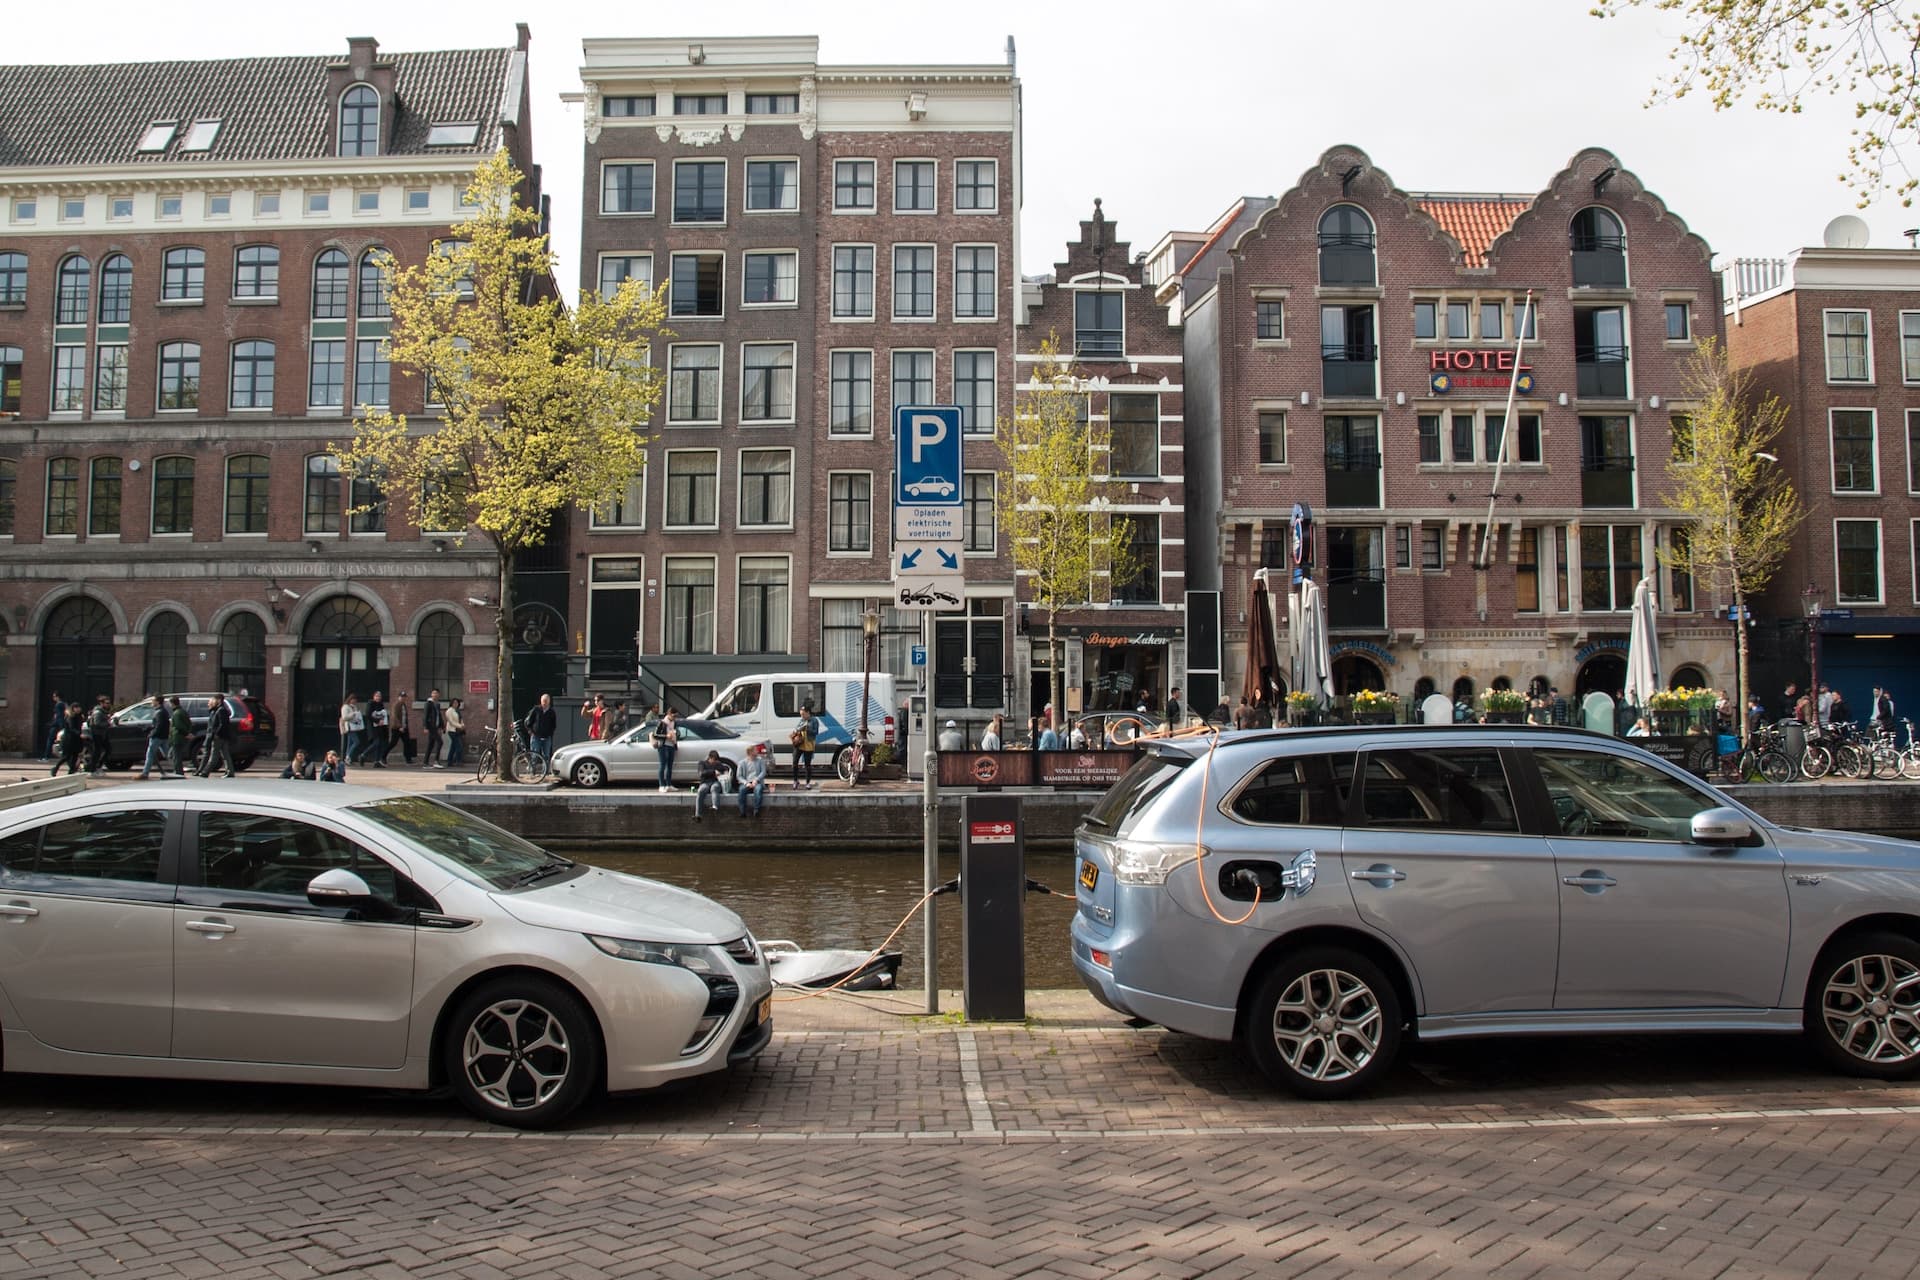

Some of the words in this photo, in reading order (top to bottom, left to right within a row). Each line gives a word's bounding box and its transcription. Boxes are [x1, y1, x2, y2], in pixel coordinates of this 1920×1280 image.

[1431, 350, 1533, 370] HOTEL
[911, 414, 947, 463] P
[914, 509, 945, 517] Opladen
[907, 519, 952, 527] elektrische
[909, 530, 951, 538] voertuigen
[1087, 632, 1128, 648] Burger
[1131, 633, 1168, 645] Zaken
[916, 653, 923, 664] P
